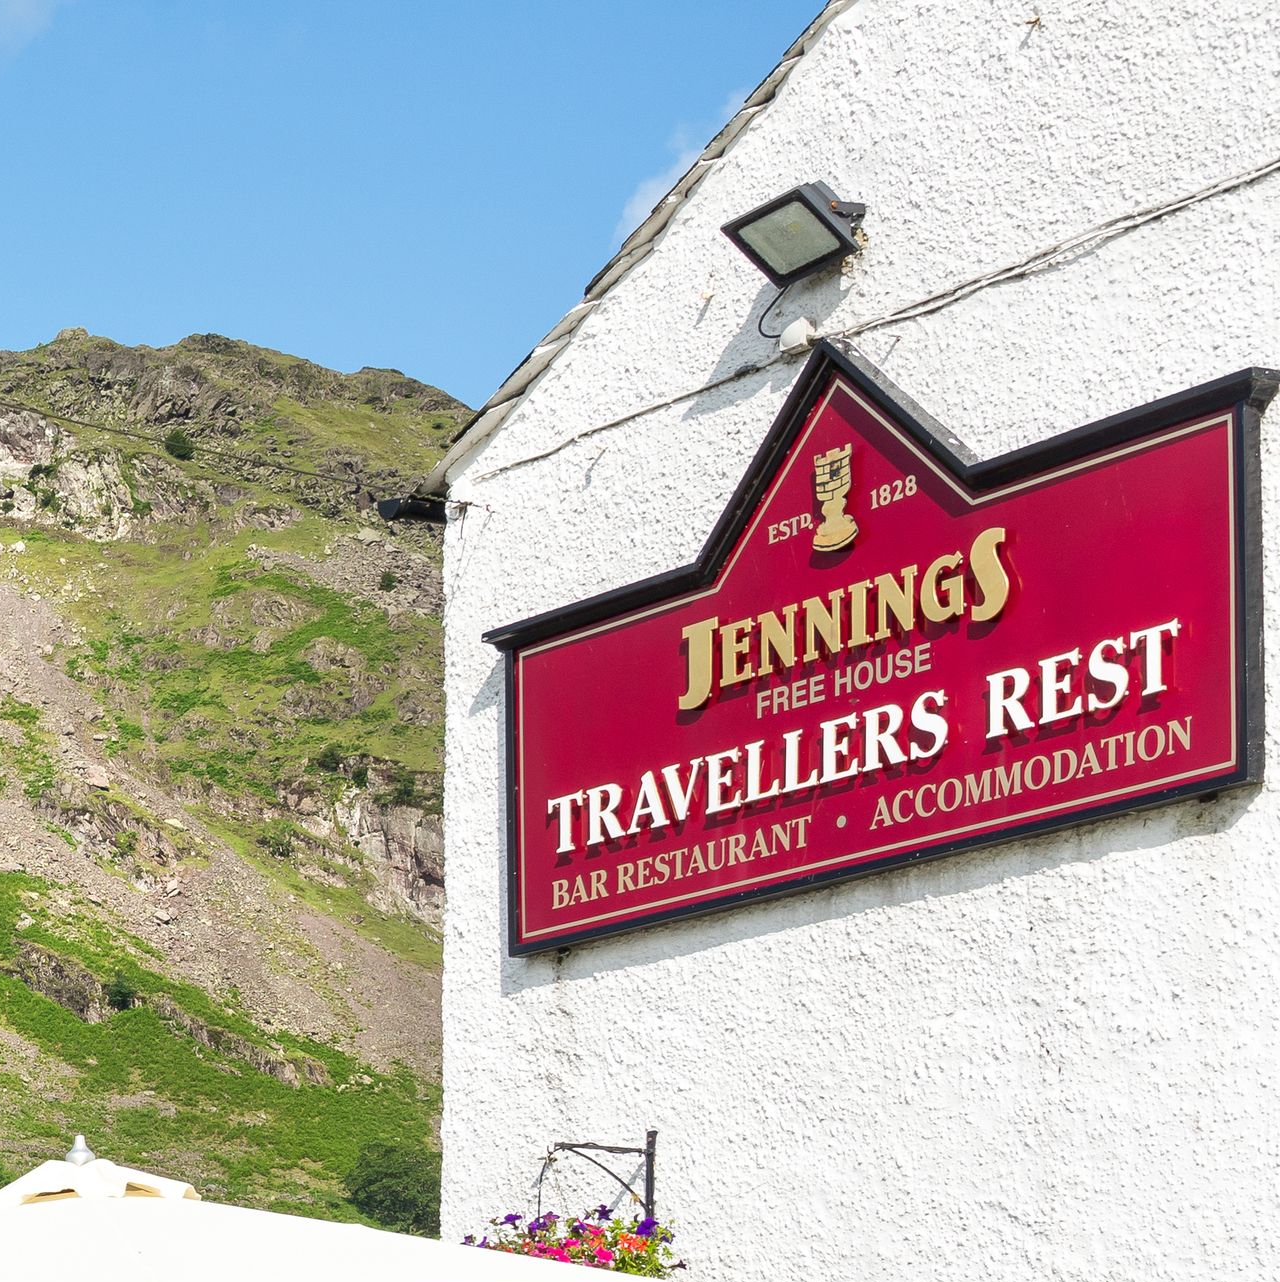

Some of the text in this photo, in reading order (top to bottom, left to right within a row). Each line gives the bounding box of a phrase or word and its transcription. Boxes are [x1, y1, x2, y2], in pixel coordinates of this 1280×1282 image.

[767, 474, 918, 545] ESTD. 1828
[678, 526, 1011, 711] JENNINGS
[756, 641, 933, 720] FREE HOUSE
[547, 617, 1182, 854] TRAVELLERS REST
[551, 715, 1193, 910] BAR RESTAURANT ACCOMMODATION
